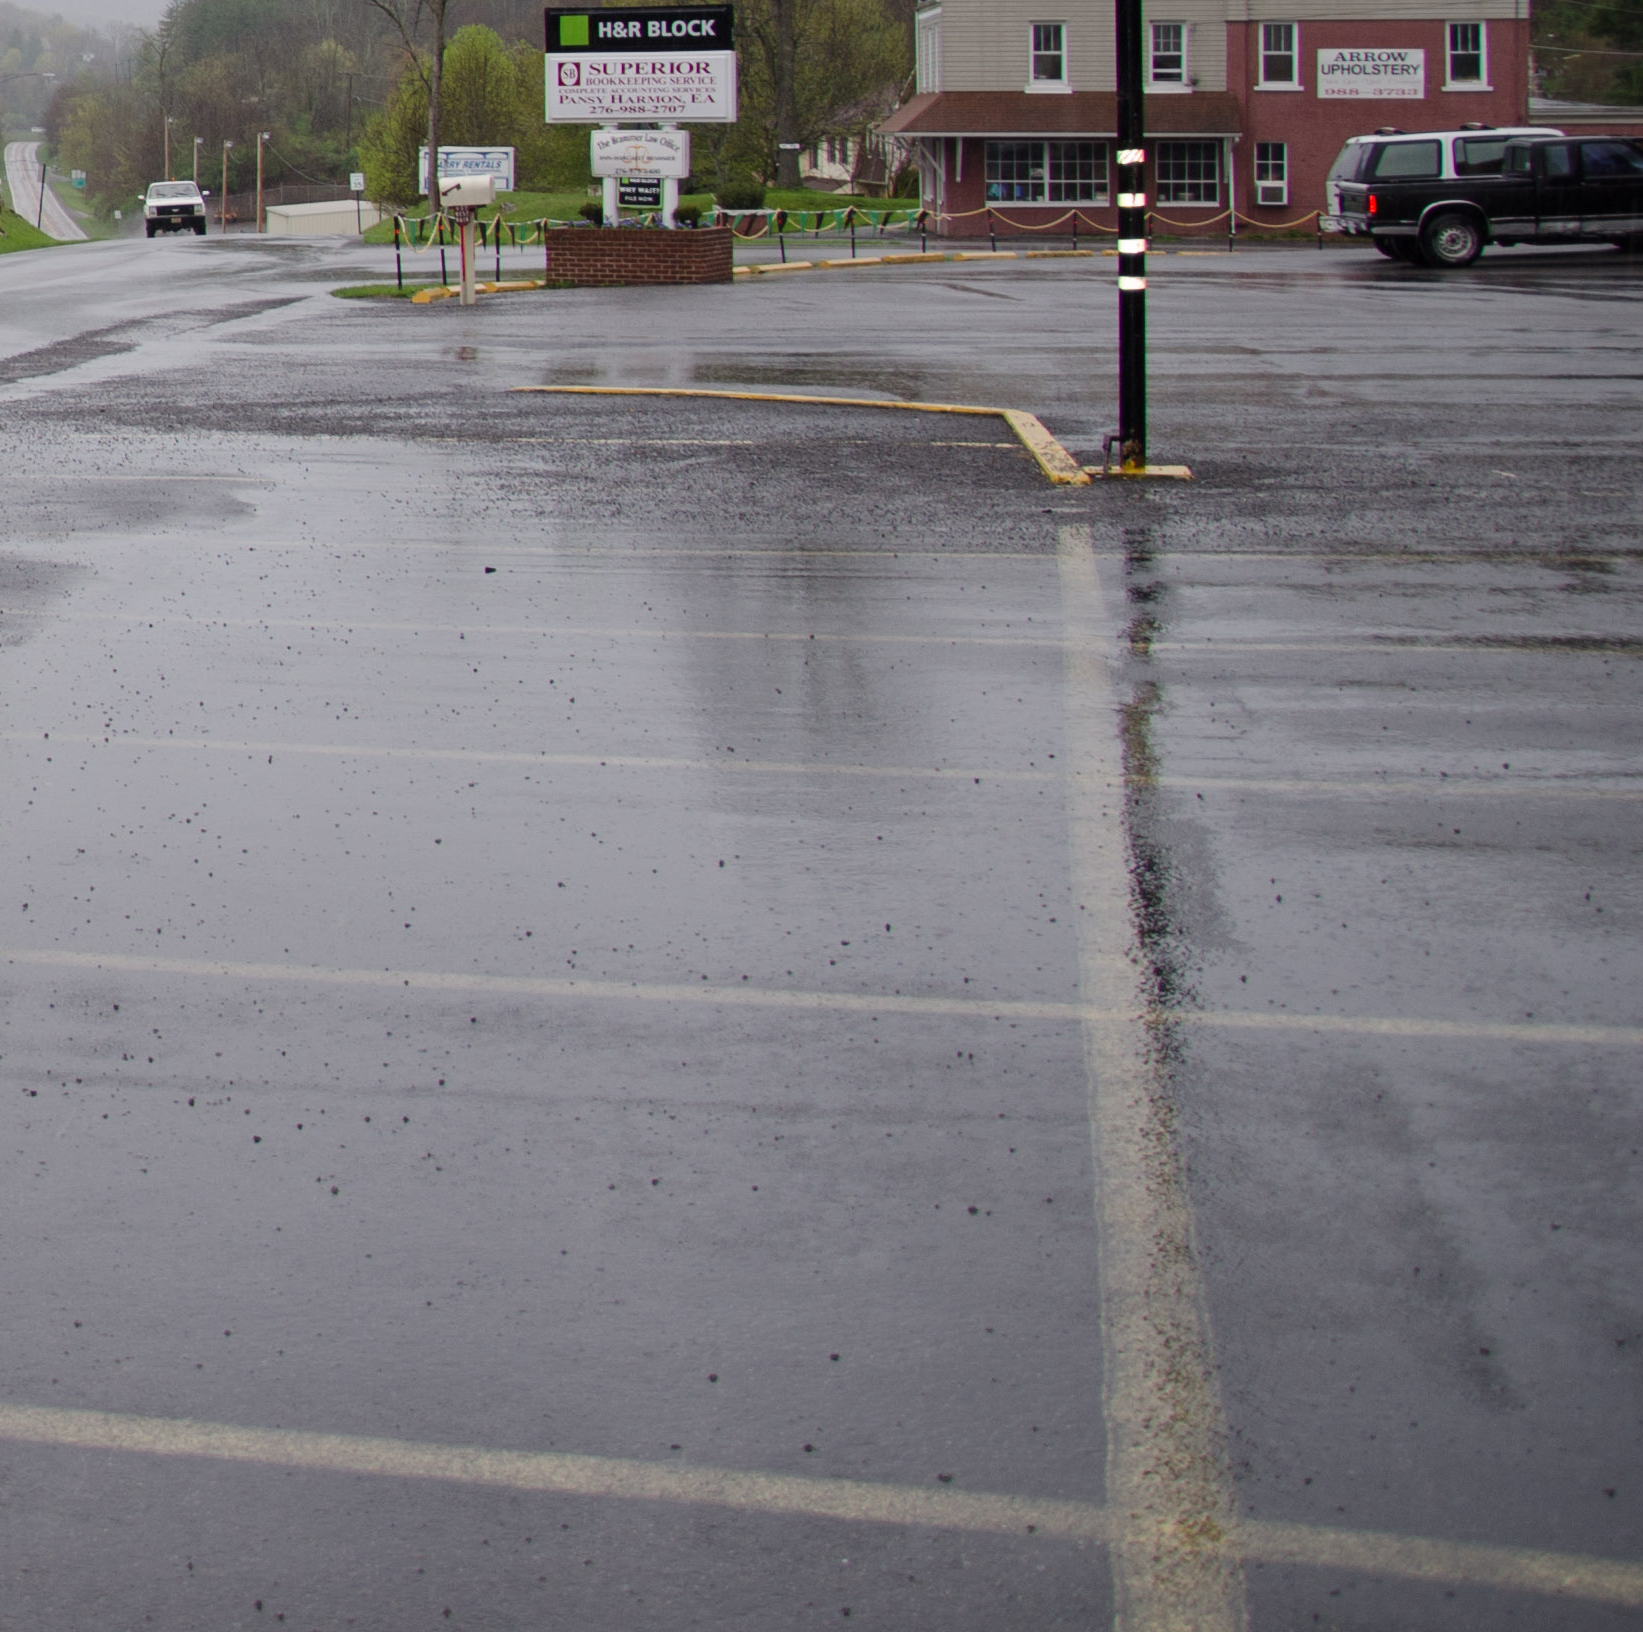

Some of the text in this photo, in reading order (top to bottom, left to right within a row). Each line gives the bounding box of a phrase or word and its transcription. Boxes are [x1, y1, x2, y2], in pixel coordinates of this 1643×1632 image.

[598, 20, 715, 38] H&R BLOCK
[1333, 52, 1408, 62] ARROW
[588, 60, 711, 76] SUPERIOR
[1321, 64, 1420, 75] UPHOLSTERY
[563, 68, 576, 79] SB
[586, 76, 717, 86] BOOKKEEPING SERVICE
[691, 94, 715, 104] EA
[588, 105, 686, 115] 276-988-2707
[644, 133, 658, 143] Law
[659, 137, 680, 152] Office
[462, 160, 502, 169] RENTALS
